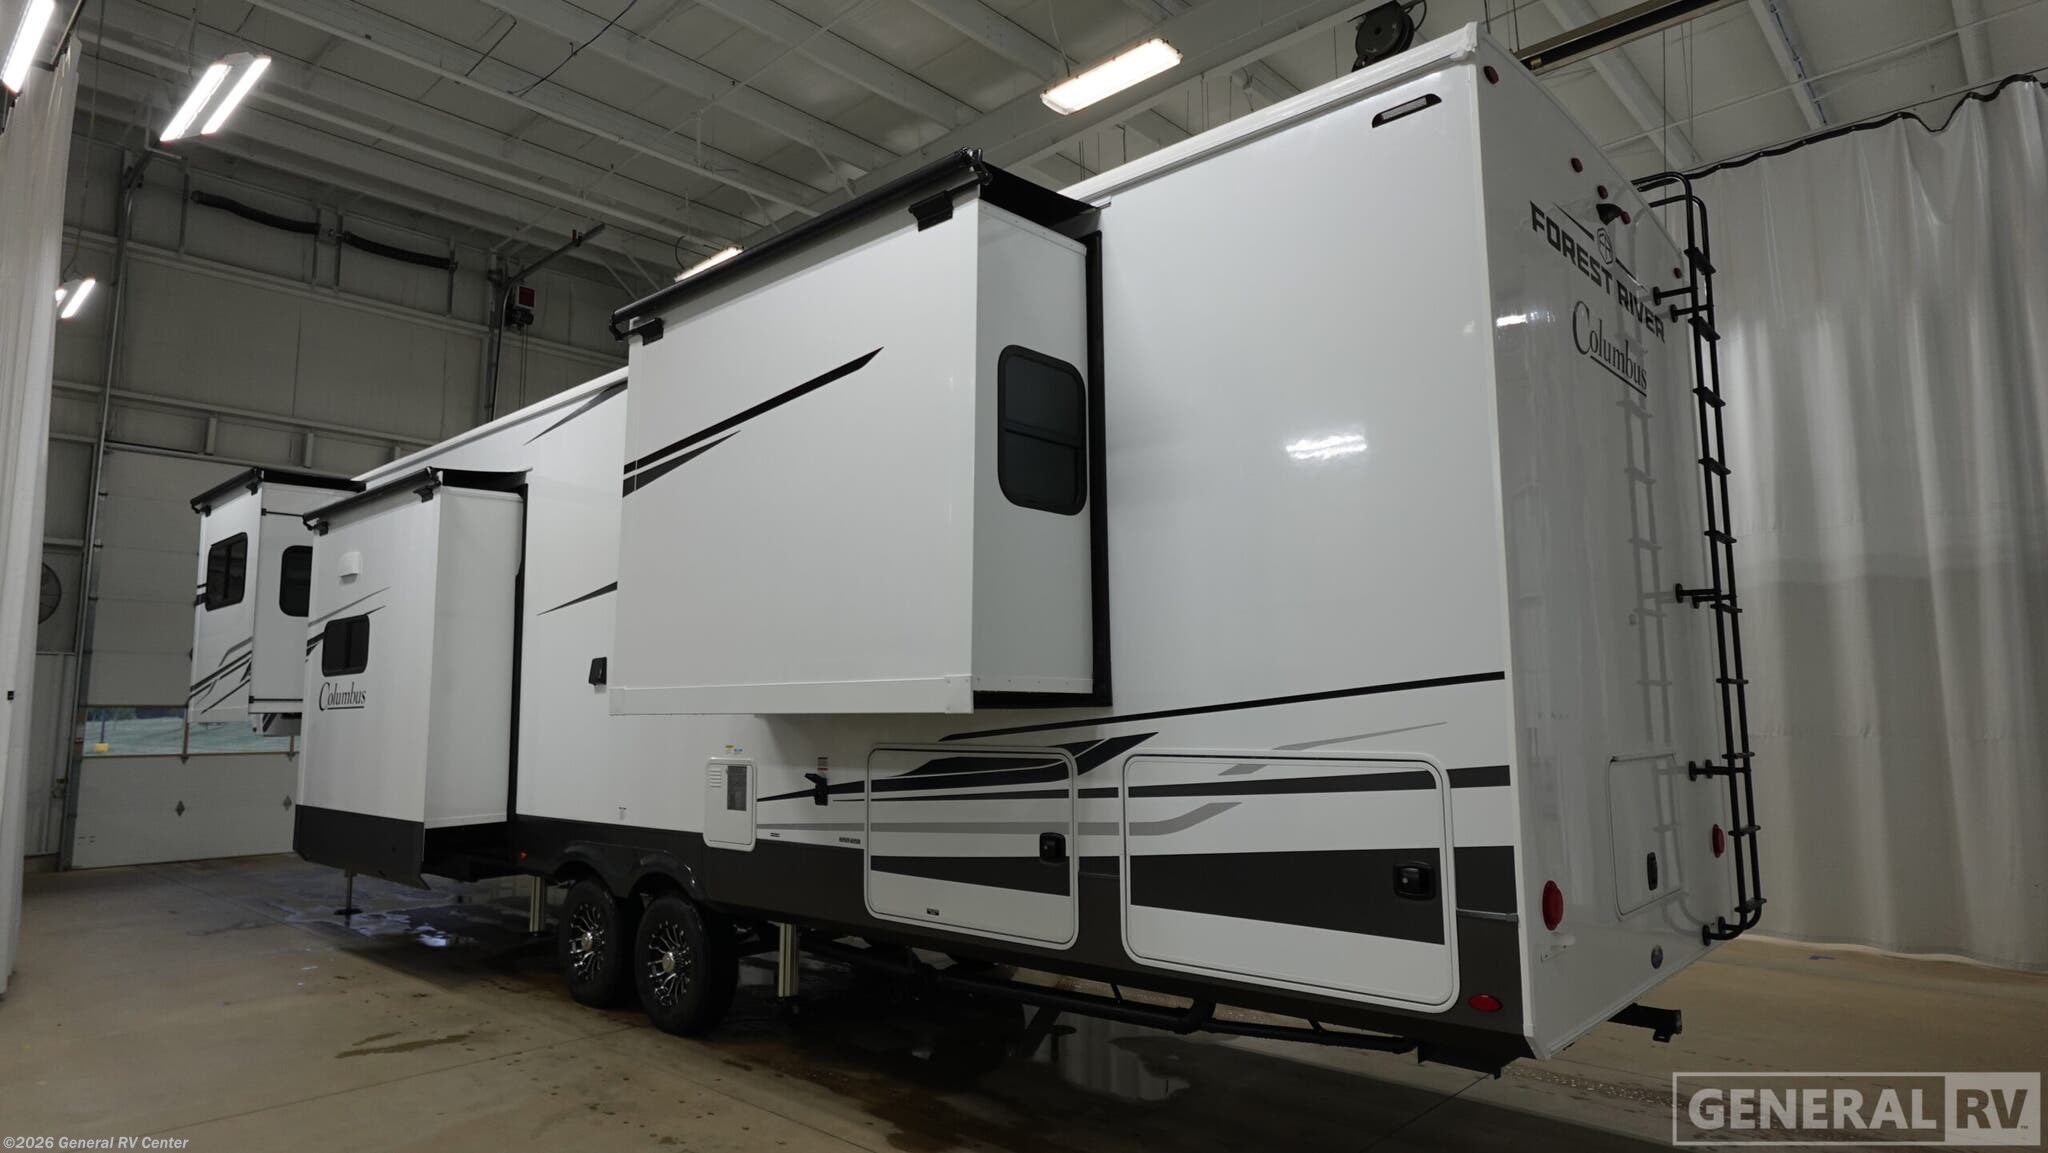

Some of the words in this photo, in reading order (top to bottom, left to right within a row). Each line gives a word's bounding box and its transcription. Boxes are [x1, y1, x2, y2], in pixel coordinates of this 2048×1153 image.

[1529, 200, 1613, 295] FOREST
[1616, 279, 1666, 344] RIVER
[1572, 300, 1648, 391] Columbus
[318, 681, 367, 711] Columbus
